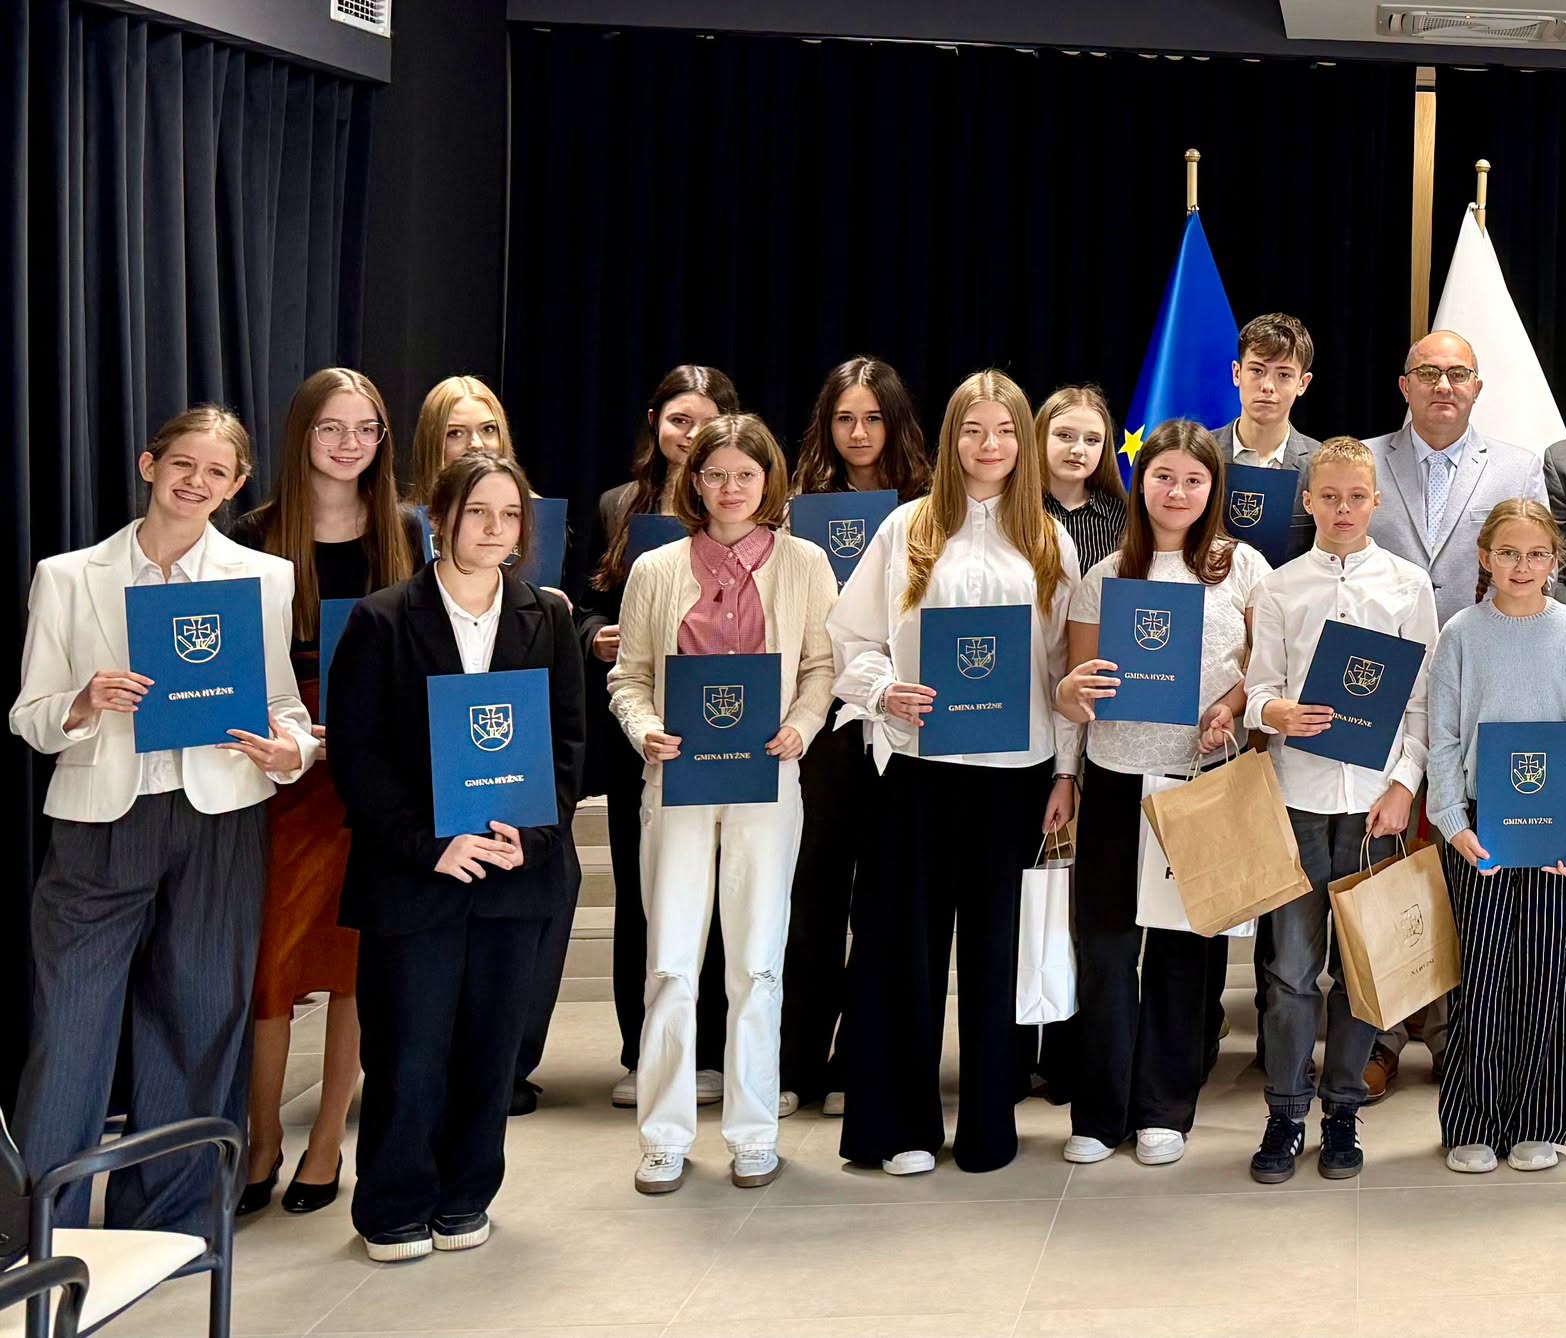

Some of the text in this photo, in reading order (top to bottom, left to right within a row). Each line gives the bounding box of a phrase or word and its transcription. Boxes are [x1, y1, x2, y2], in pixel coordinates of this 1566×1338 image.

[1124, 672, 1175, 681] GMINA HYŻNE
[168, 686, 234, 701] GMINA HYŻNE
[976, 702, 1003, 710] HYŻNE
[694, 752, 751, 761] GMINA HYŻNE
[464, 774, 525, 787] GMINA HYŻNE
[1503, 817, 1553, 826] GMINA HYŻNE
